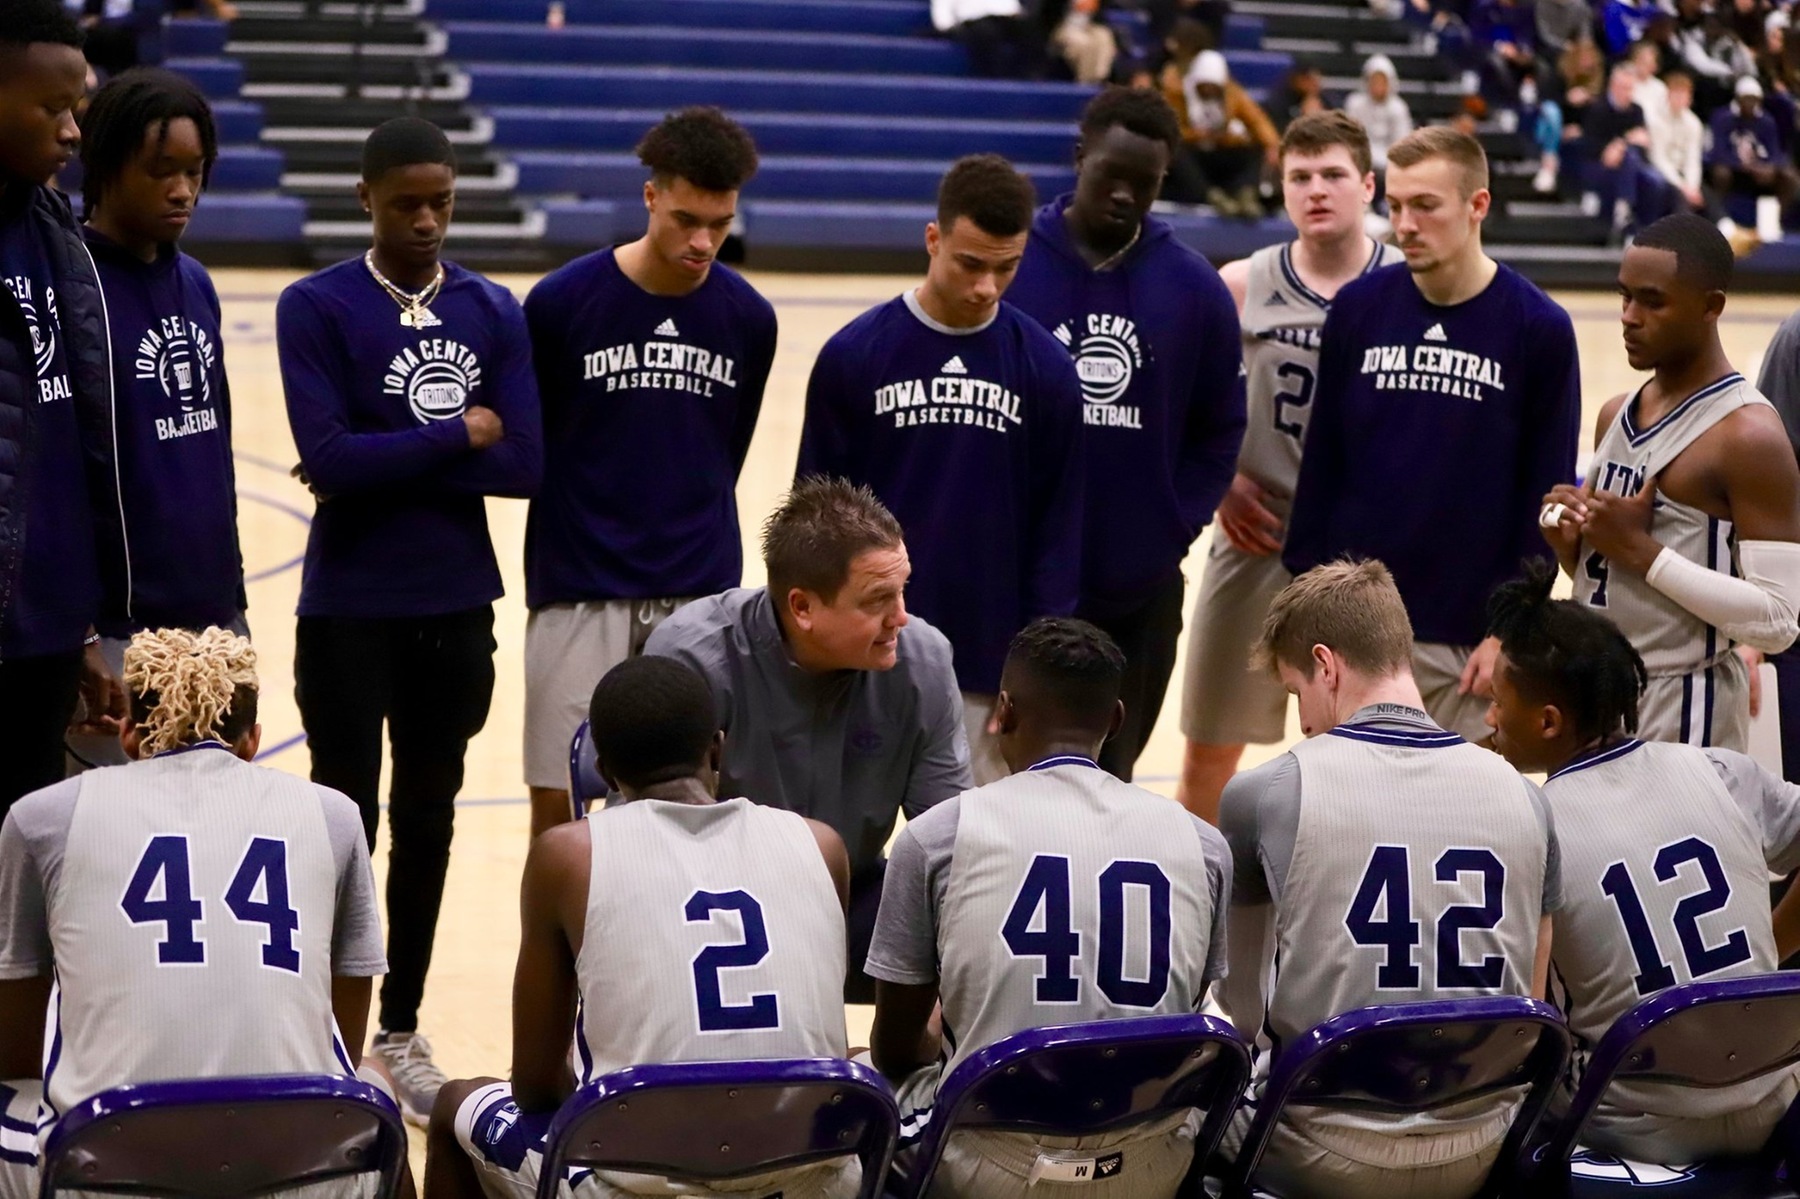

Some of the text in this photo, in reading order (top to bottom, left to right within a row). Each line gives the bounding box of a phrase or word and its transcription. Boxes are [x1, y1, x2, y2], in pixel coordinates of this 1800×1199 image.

[136, 329, 164, 378] IOWA
[383, 339, 481, 394] IOWA CENTRAL
[584, 342, 736, 388] IOWA CENTRAL
[1361, 345, 1505, 391] IOWA CENTRAL
[422, 387, 459, 404] TRITONS
[875, 377, 1022, 425] IOWA CENTRAL
[1274, 362, 1315, 439] 2
[1376, 373, 1482, 401] BASKETBALL
[895, 407, 1007, 433] BASKETBALL
[1083, 403, 1142, 429] KETBALL
[1377, 703, 1426, 719] NIKE PRO
[117, 833, 302, 977] 44
[1342, 842, 1507, 992] 42
[1598, 834, 1754, 998] 12
[998, 852, 1173, 1011] 40
[681, 887, 782, 1035] 2
[1074, 1165, 1088, 1177] M
